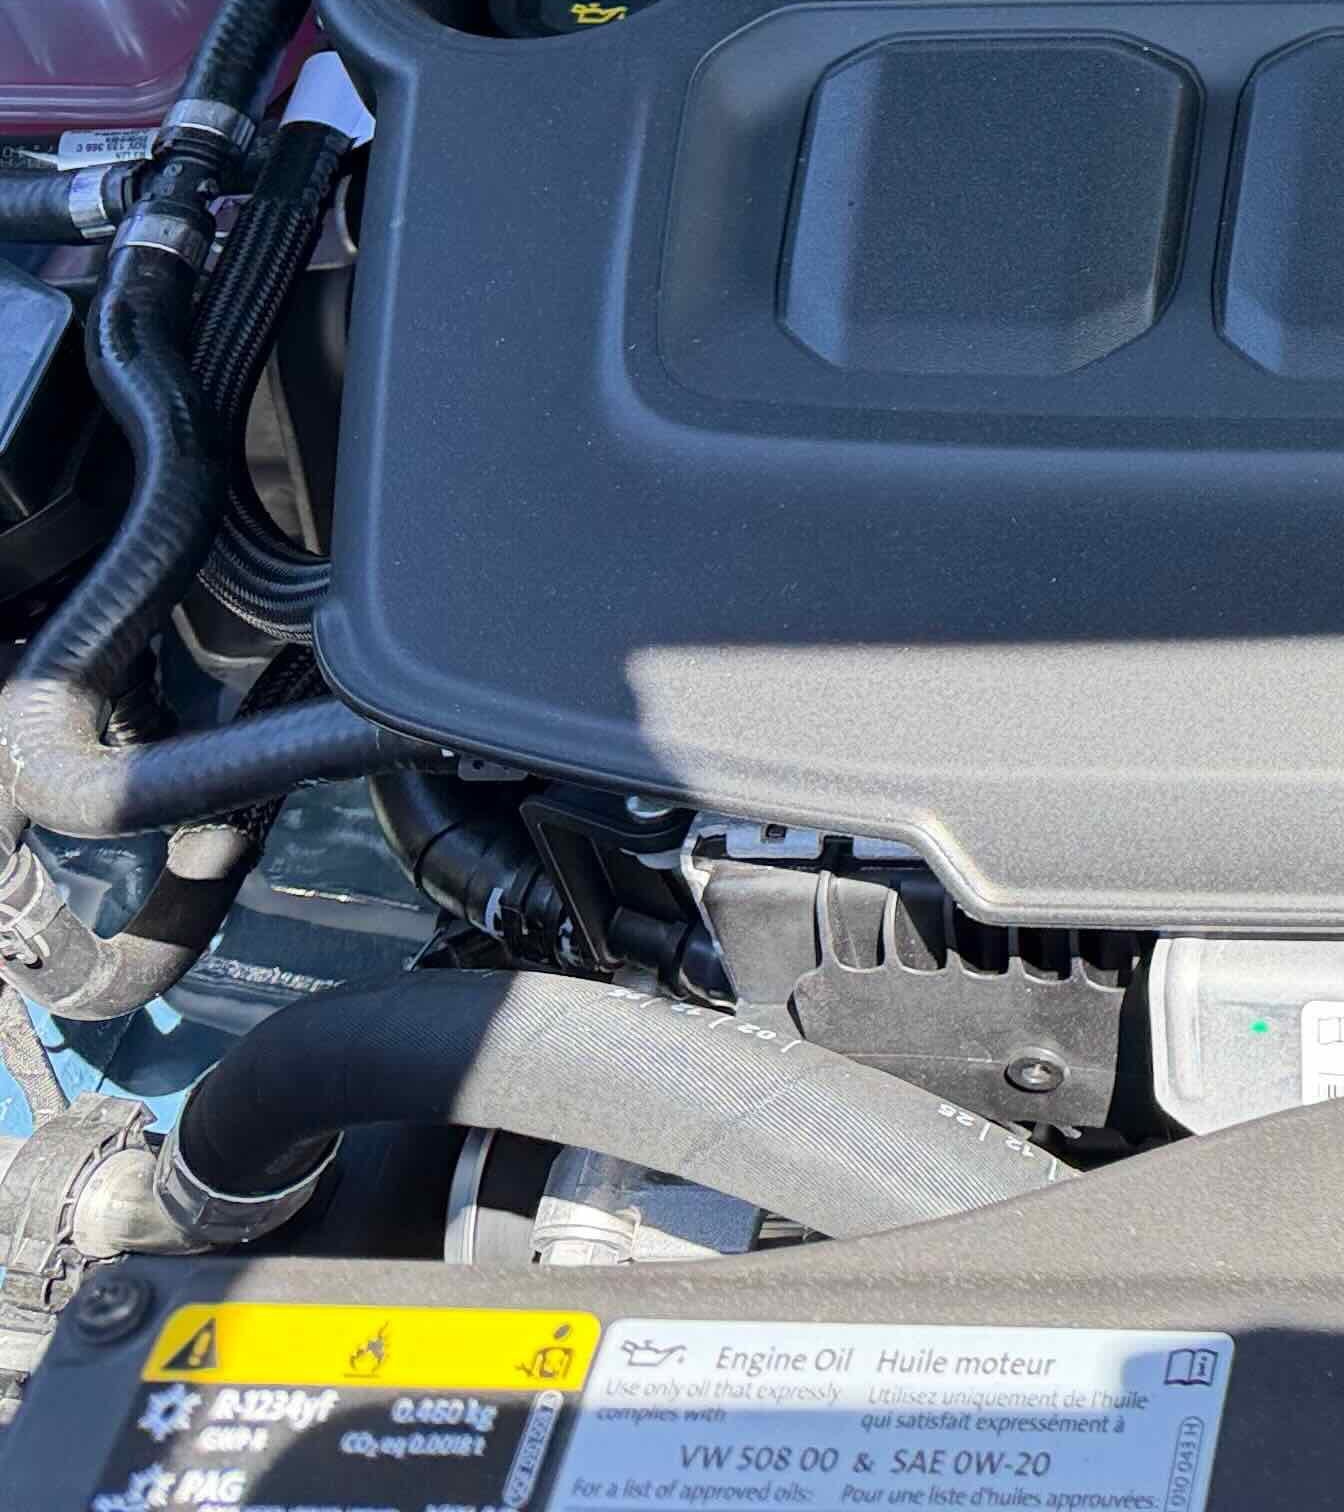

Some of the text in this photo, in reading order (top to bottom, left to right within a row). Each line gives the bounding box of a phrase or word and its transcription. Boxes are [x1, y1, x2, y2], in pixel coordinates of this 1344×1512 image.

[716, 1346, 853, 1377] Engine Oil
[877, 1349, 1057, 1376] Huile moteur
[605, 1378, 842, 1406] Use only oil that expressly
[866, 1386, 1150, 1411] Utilisez uniquement de l'huile
[596, 1407, 727, 1425] complies with
[860, 1412, 1125, 1435] qui satisfait expressément à
[679, 1444, 1052, 1477] VW 508 00 & SAE 0W-20
[174, 1467, 247, 1504] PAG
[572, 1478, 602, 1497] For
[605, 1483, 618, 1498] a
[622, 1479, 650, 1499] list
[655, 1480, 678, 1499] of
[679, 1481, 769, 1504] approved
[841, 1484, 883, 1504] Pour
[887, 1488, 922, 1505] une
[928, 1487, 966, 1506] liste
[970, 1487, 1041, 1507] d'huiles
